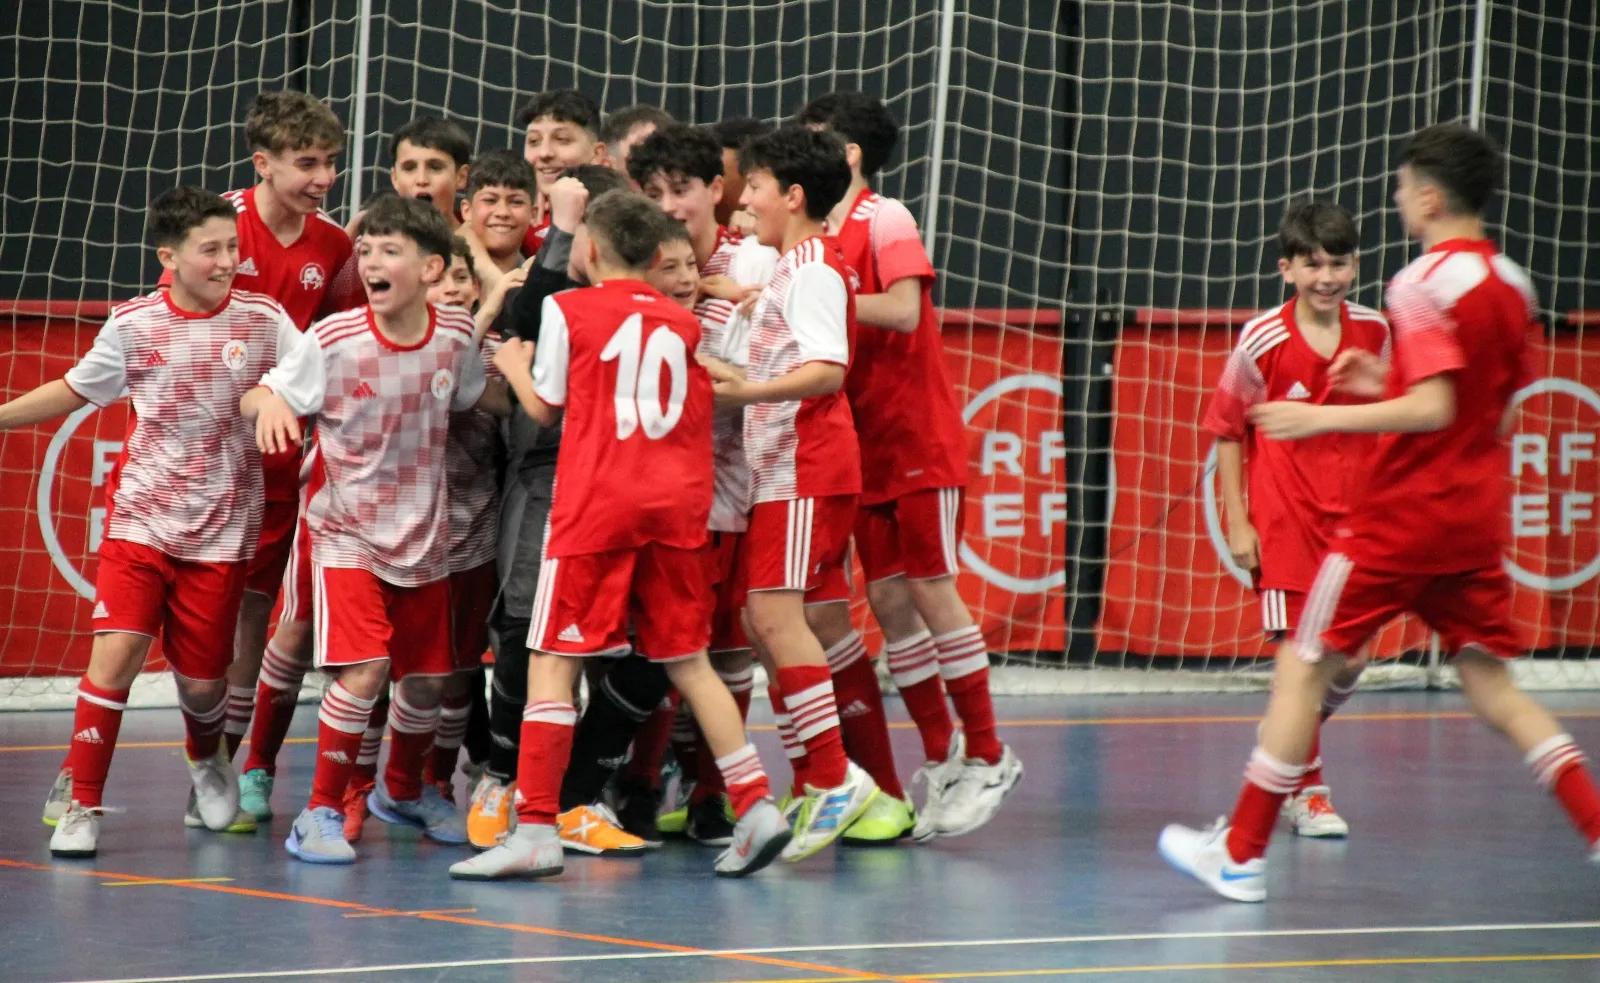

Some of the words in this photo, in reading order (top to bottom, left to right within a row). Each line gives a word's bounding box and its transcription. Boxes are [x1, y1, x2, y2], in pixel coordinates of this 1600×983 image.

[600, 312, 688, 440] 10
[1511, 433, 1596, 476] RF
[1511, 494, 1594, 536] EF
